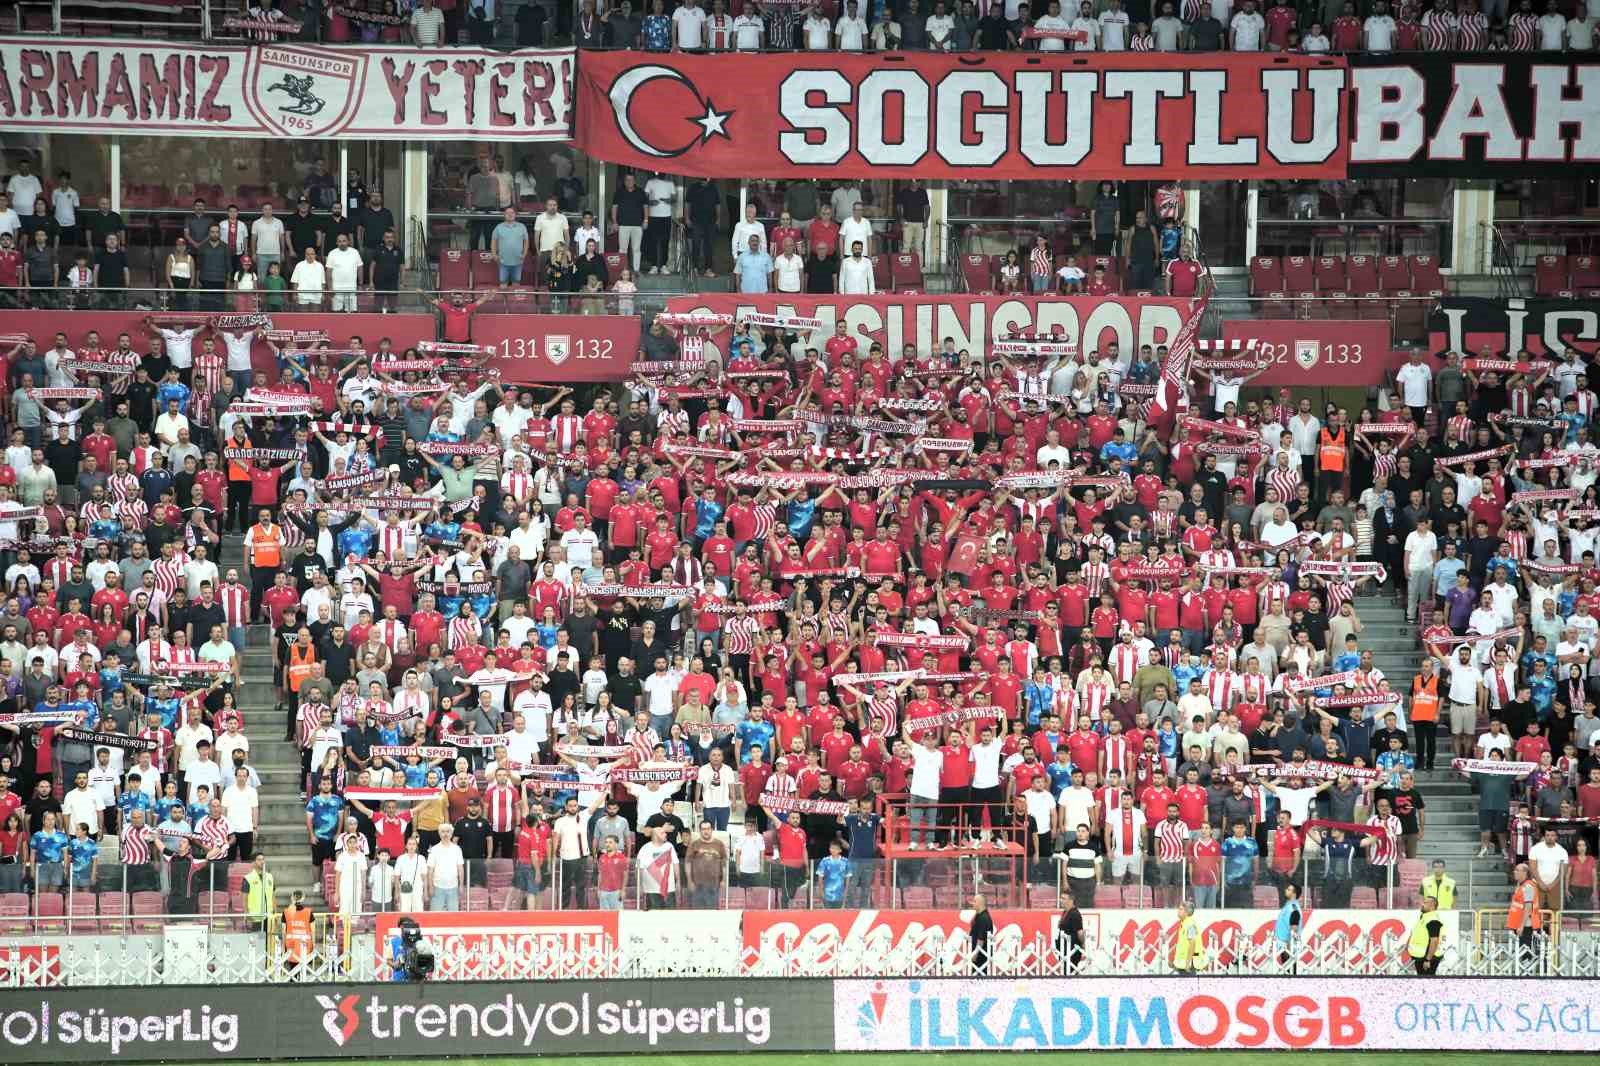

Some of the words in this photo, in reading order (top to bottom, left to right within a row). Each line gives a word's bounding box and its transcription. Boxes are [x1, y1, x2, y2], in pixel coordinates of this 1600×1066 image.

[263, 51, 351, 74] SAMSUNSPOR
[280, 115, 313, 130] 1965
[501, 338, 539, 359] 131
[575, 338, 614, 360] 132
[1325, 343, 1362, 364] 133
[327, 473, 374, 489] SAMSUNSPOR
[628, 587, 687, 597] SAMSUNSPOR
[1299, 673, 1346, 688] SAMSUNSPOR
[1331, 694, 1384, 705] SAMSUNSPOR
[373, 748, 417, 757] SAMSUN
[426, 750, 454, 758] SPOR
[629, 771, 682, 781] SAMSUNSPOR
[366, 993, 589, 1047] trendyol
[598, 998, 771, 1045] süperLig
[909, 980, 1173, 1048] İLKADIM
[1177, 995, 1365, 1047] OSGB
[1394, 1002, 1506, 1033] ORTAK
[58, 1004, 239, 1055] süperLig
